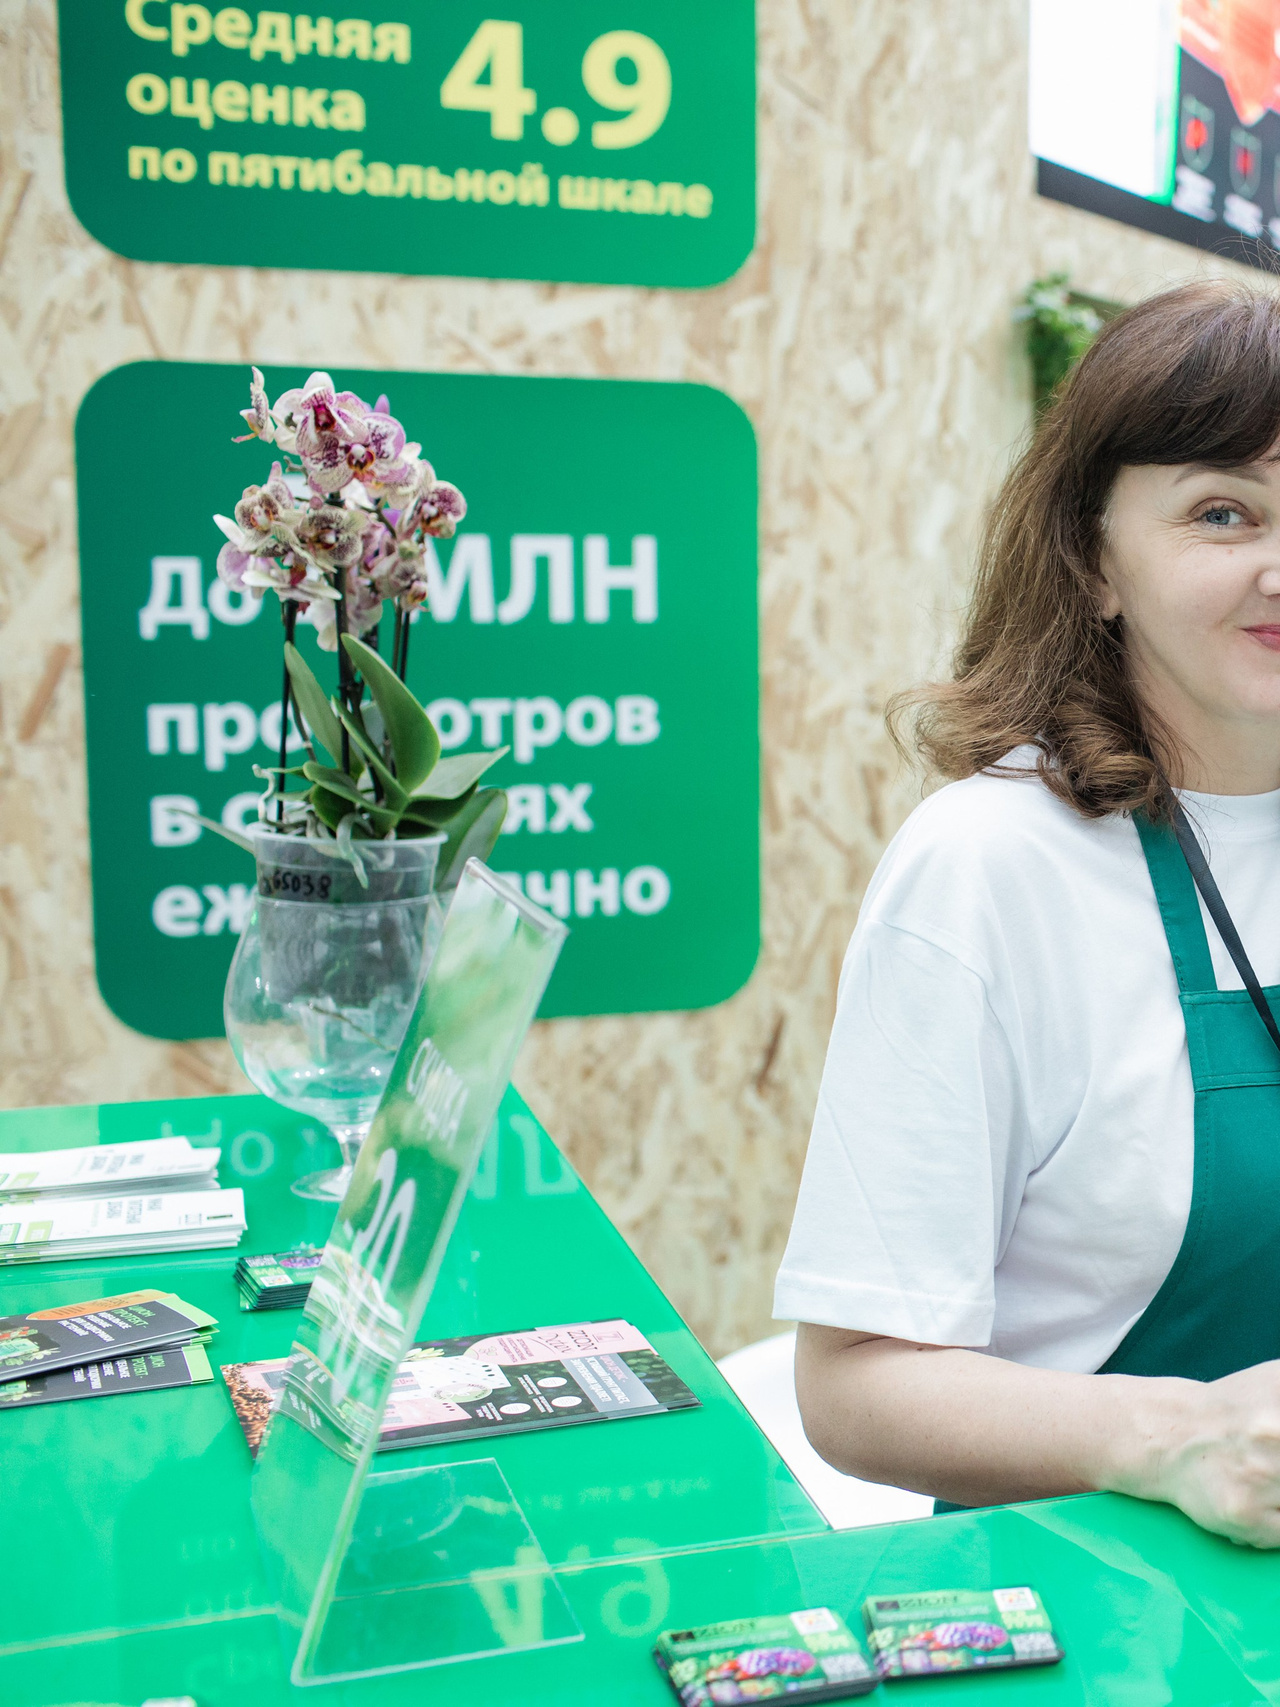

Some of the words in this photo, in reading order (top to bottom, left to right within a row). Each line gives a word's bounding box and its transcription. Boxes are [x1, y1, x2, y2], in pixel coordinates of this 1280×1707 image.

[124, 0, 412, 65] Средняя
[126, 72, 366, 133] оценка
[440, 18, 673, 151] 4.9
[128, 145, 197, 183] по
[208, 149, 550, 208] пятибальной
[558, 175, 714, 219] шкале
[412, 533, 659, 626] МЛН
[146, 695, 661, 772] проотров
